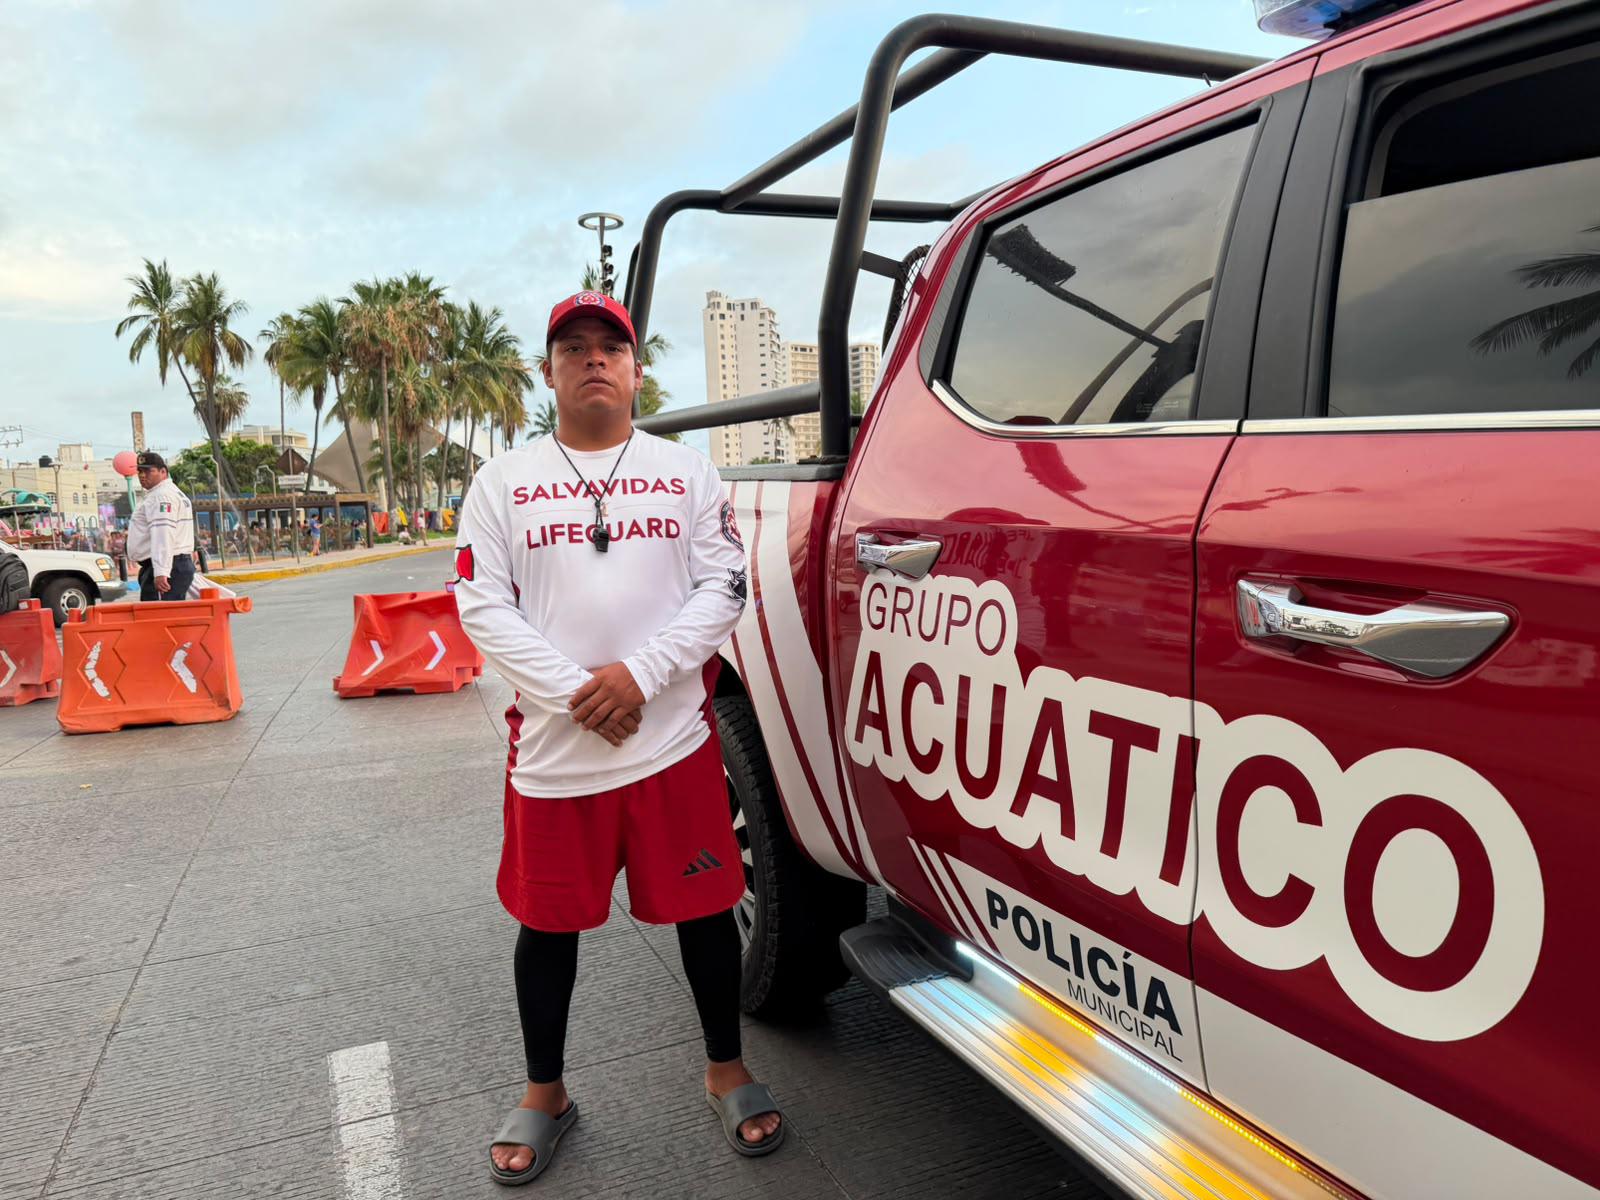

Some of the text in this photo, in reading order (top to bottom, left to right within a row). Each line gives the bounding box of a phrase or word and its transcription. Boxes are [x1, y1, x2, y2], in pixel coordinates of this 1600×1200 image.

[512, 477, 686, 505] SALVAVIDAS
[866, 582, 1007, 657] GRUPO
[854, 650, 1496, 994] ACUATICO
[985, 887, 1183, 1037] POLICÍA
[1067, 978, 1183, 1063] MUNICIPAL
